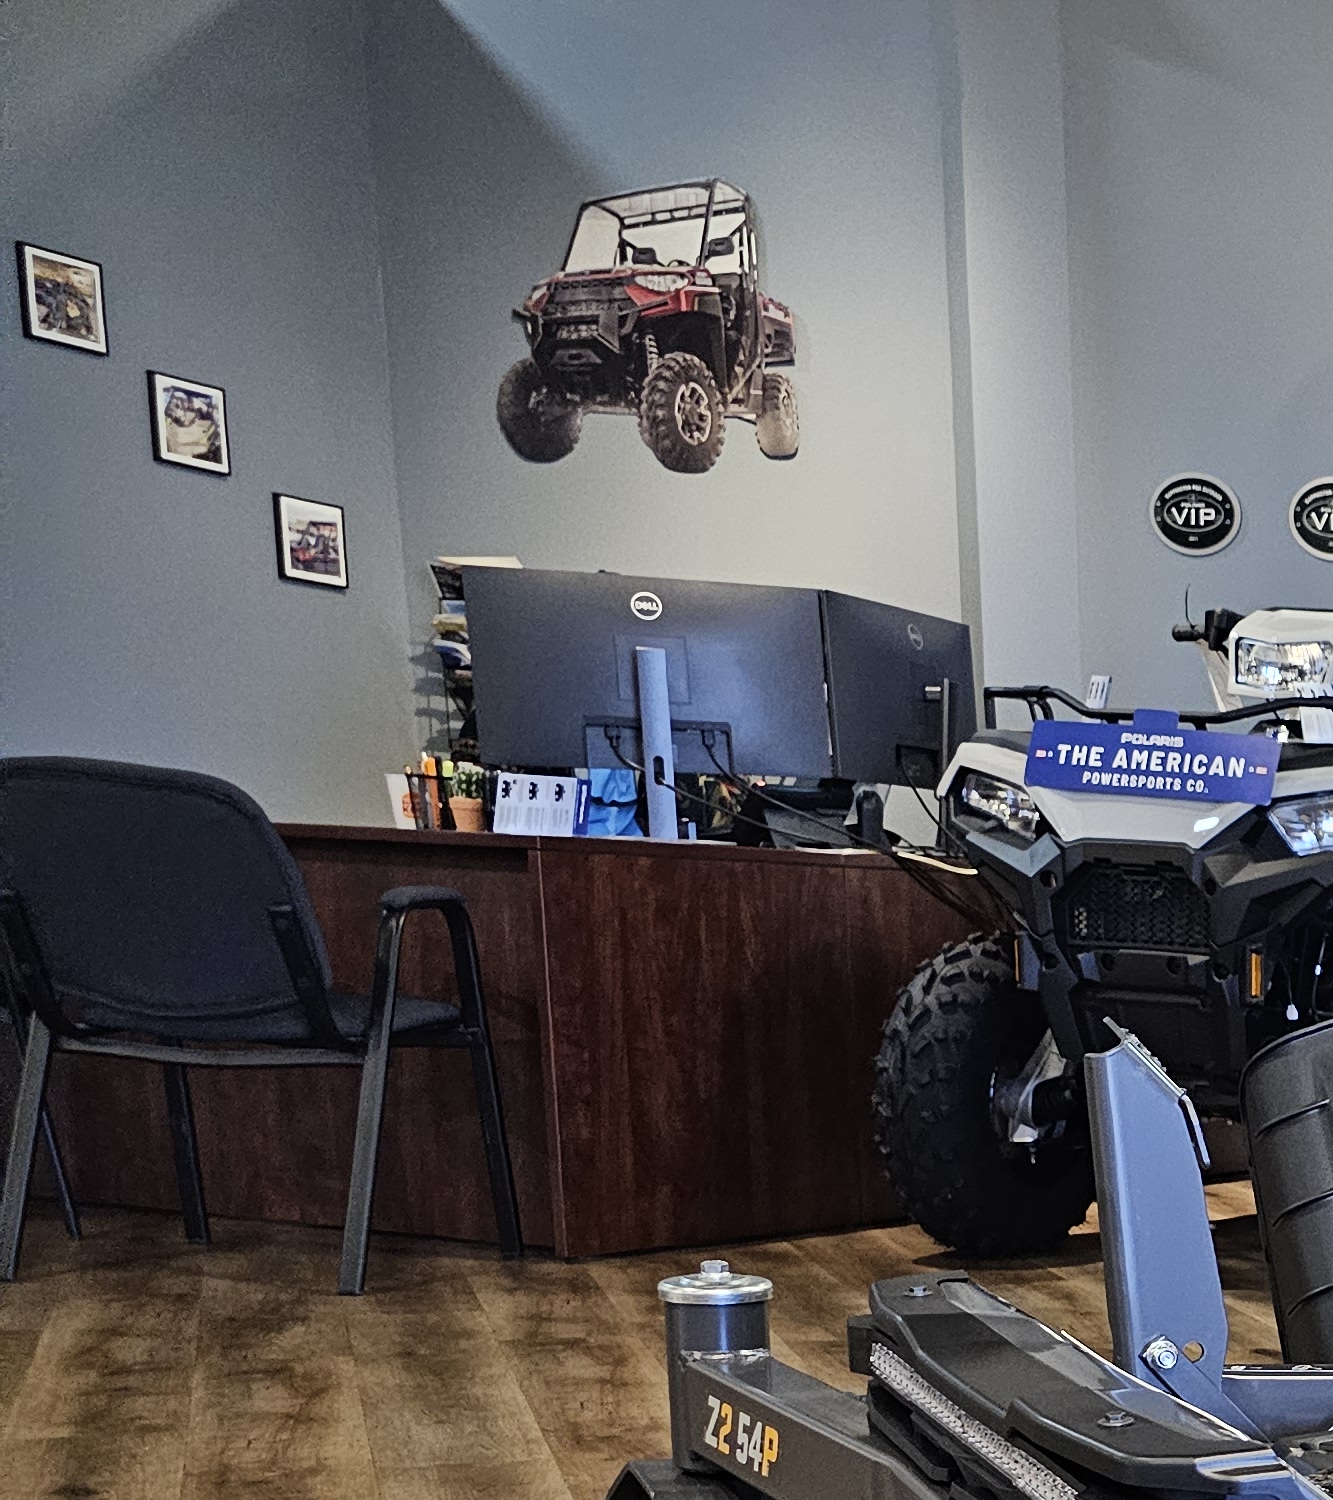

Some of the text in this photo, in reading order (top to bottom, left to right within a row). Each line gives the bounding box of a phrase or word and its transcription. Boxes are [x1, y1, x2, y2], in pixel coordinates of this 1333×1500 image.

[1170, 506, 1216, 527] VIP
[634, 600, 659, 611] DELL
[1120, 731, 1185, 748] POLARIS
[1056, 743, 1247, 779] THE AMERICAN
[1082, 770, 1182, 792] POWERSPORTS
[704, 1394, 780, 1478] Z2 54P
